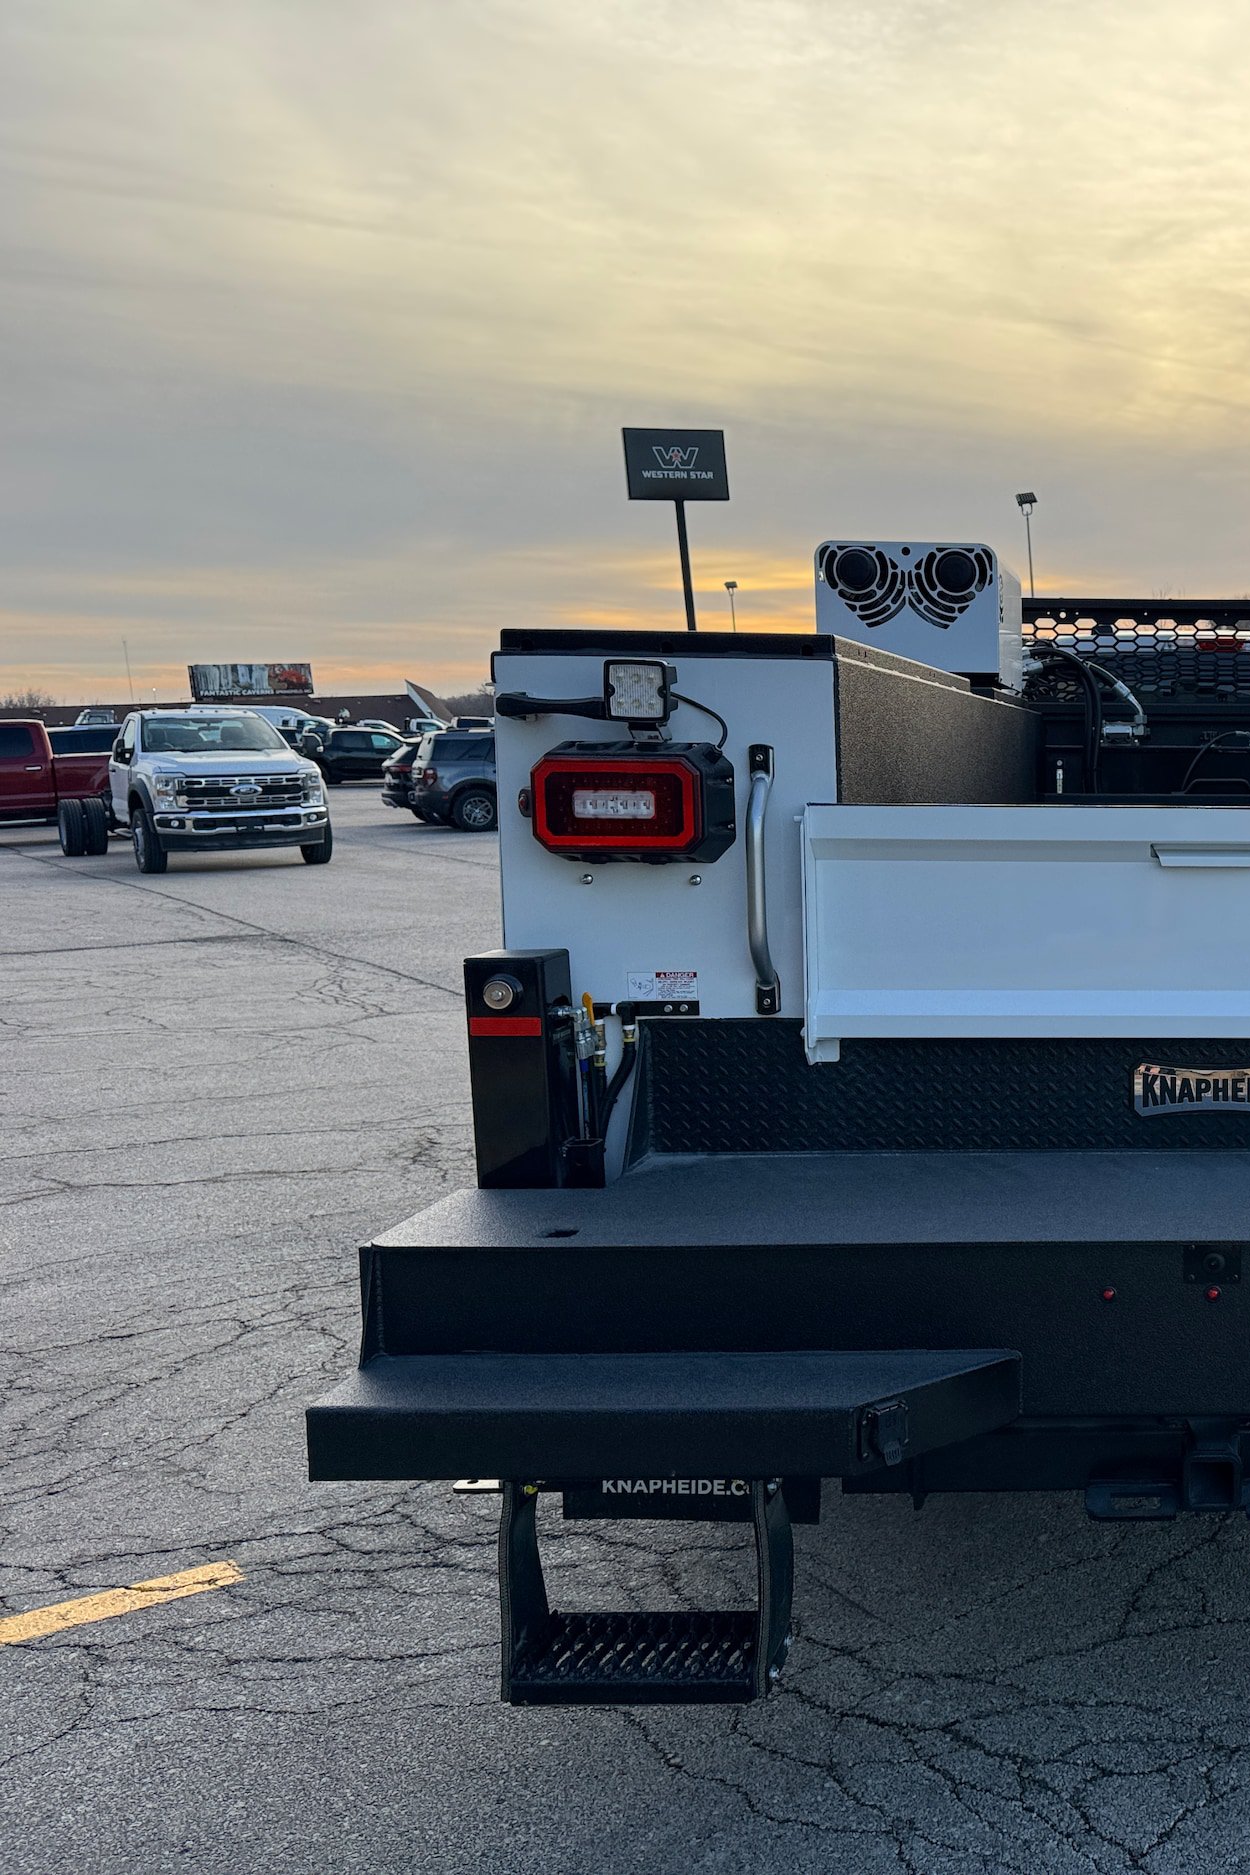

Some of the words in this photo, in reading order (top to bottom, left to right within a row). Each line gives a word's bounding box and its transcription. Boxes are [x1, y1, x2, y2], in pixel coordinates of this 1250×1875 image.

[642, 470, 687, 479] WESTERN
[690, 471, 714, 479] STAR
[602, 1479, 750, 1496] KNAPHEIDE.C
